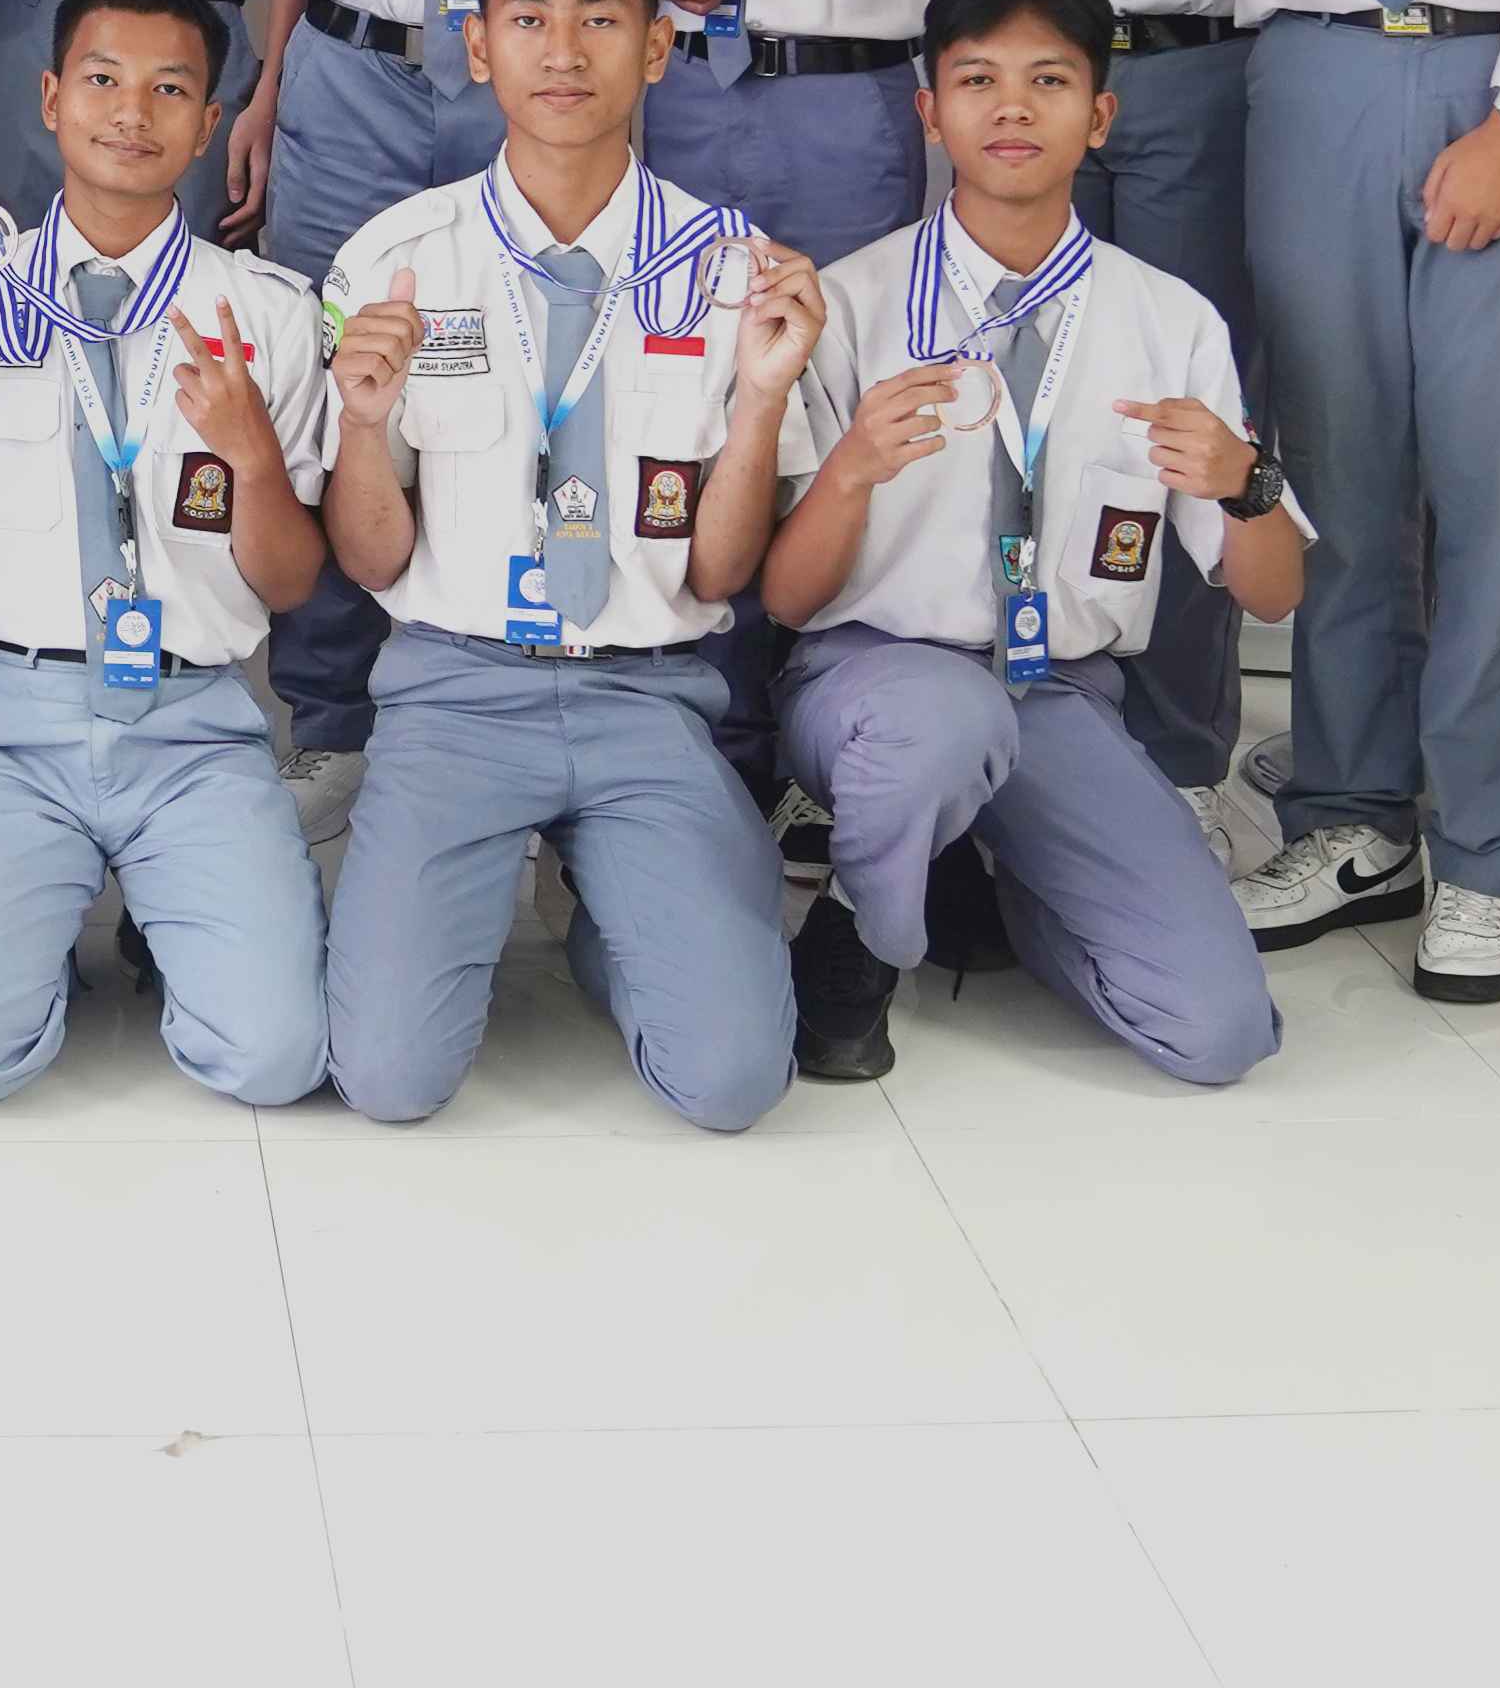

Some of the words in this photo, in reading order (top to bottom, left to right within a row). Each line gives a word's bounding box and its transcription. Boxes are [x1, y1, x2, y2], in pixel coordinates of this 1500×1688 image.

[501, 271, 521, 324] Summit
[518, 330, 533, 363] 2024
[581, 275, 627, 371] UpYourAISkll
[1054, 313, 1076, 362] Summit
[62, 331, 81, 373] ummit
[78, 376, 96, 409] 2024
[139, 314, 170, 406] UpYourAISkil
[1041, 368, 1057, 399] 2024
